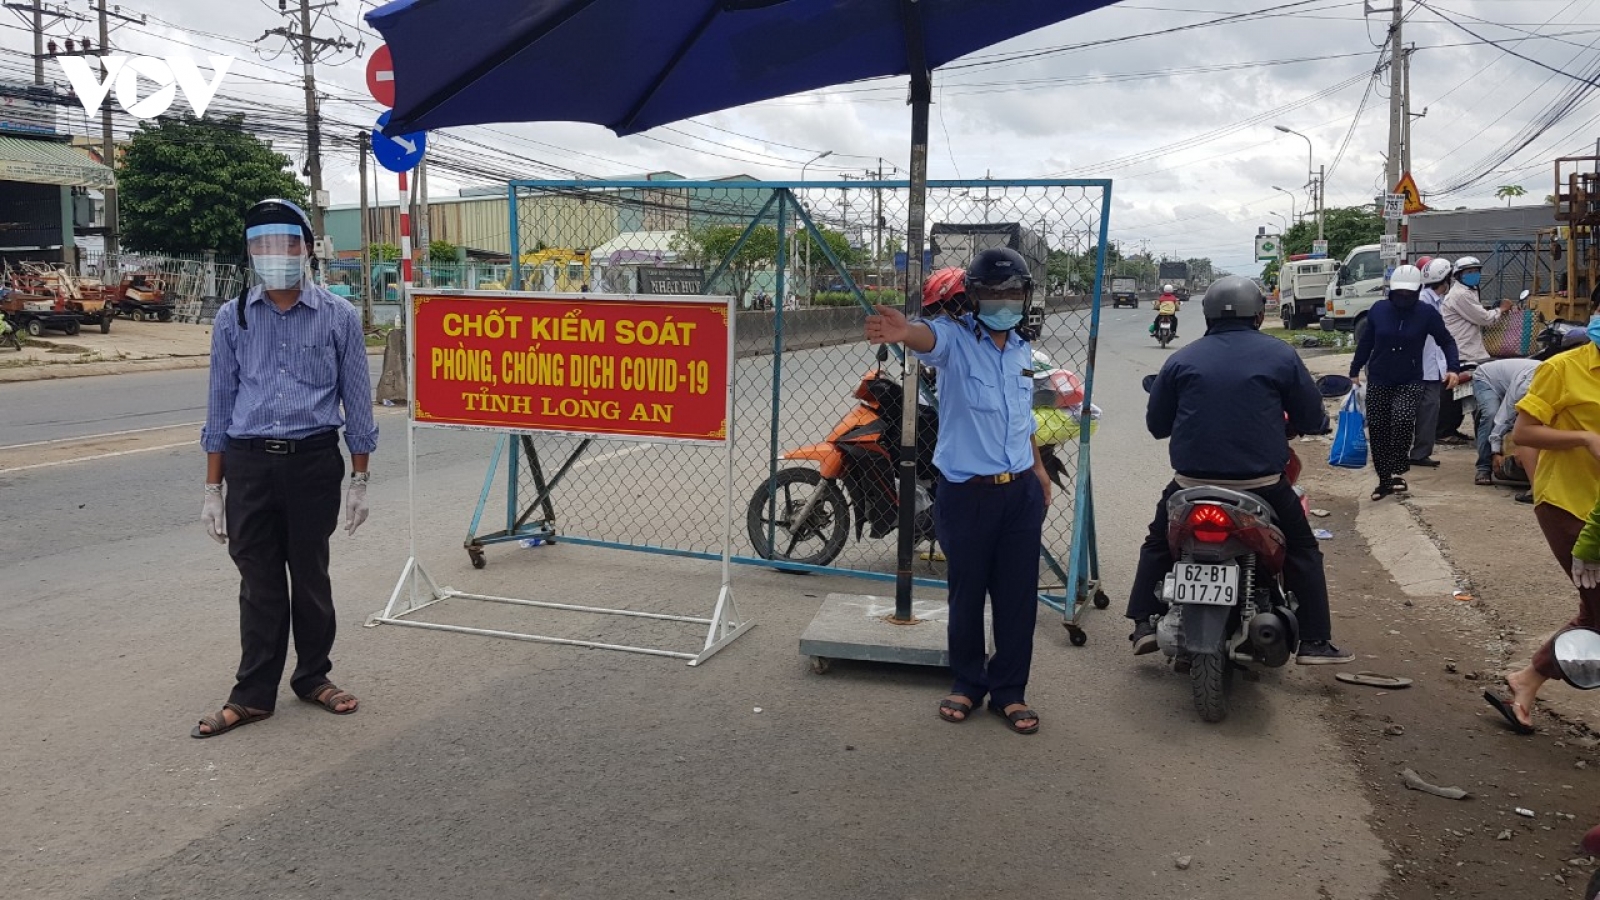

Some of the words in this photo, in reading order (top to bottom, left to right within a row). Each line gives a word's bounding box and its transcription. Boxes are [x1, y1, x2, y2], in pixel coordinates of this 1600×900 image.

[443, 307, 523, 339] CHỐT
[531, 308, 605, 343] KIỂM
[615, 315, 697, 346] SOÁT
[431, 341, 497, 387] PHÒNG,
[502, 342, 565, 387] CHỐNG
[570, 354, 615, 395] DỊCH
[620, 355, 709, 395] COVID-19
[461, 386, 533, 415] TỈNH
[541, 397, 622, 420] LONG
[628, 403, 674, 423] AN
[1177, 583, 1234, 603] 017.79
